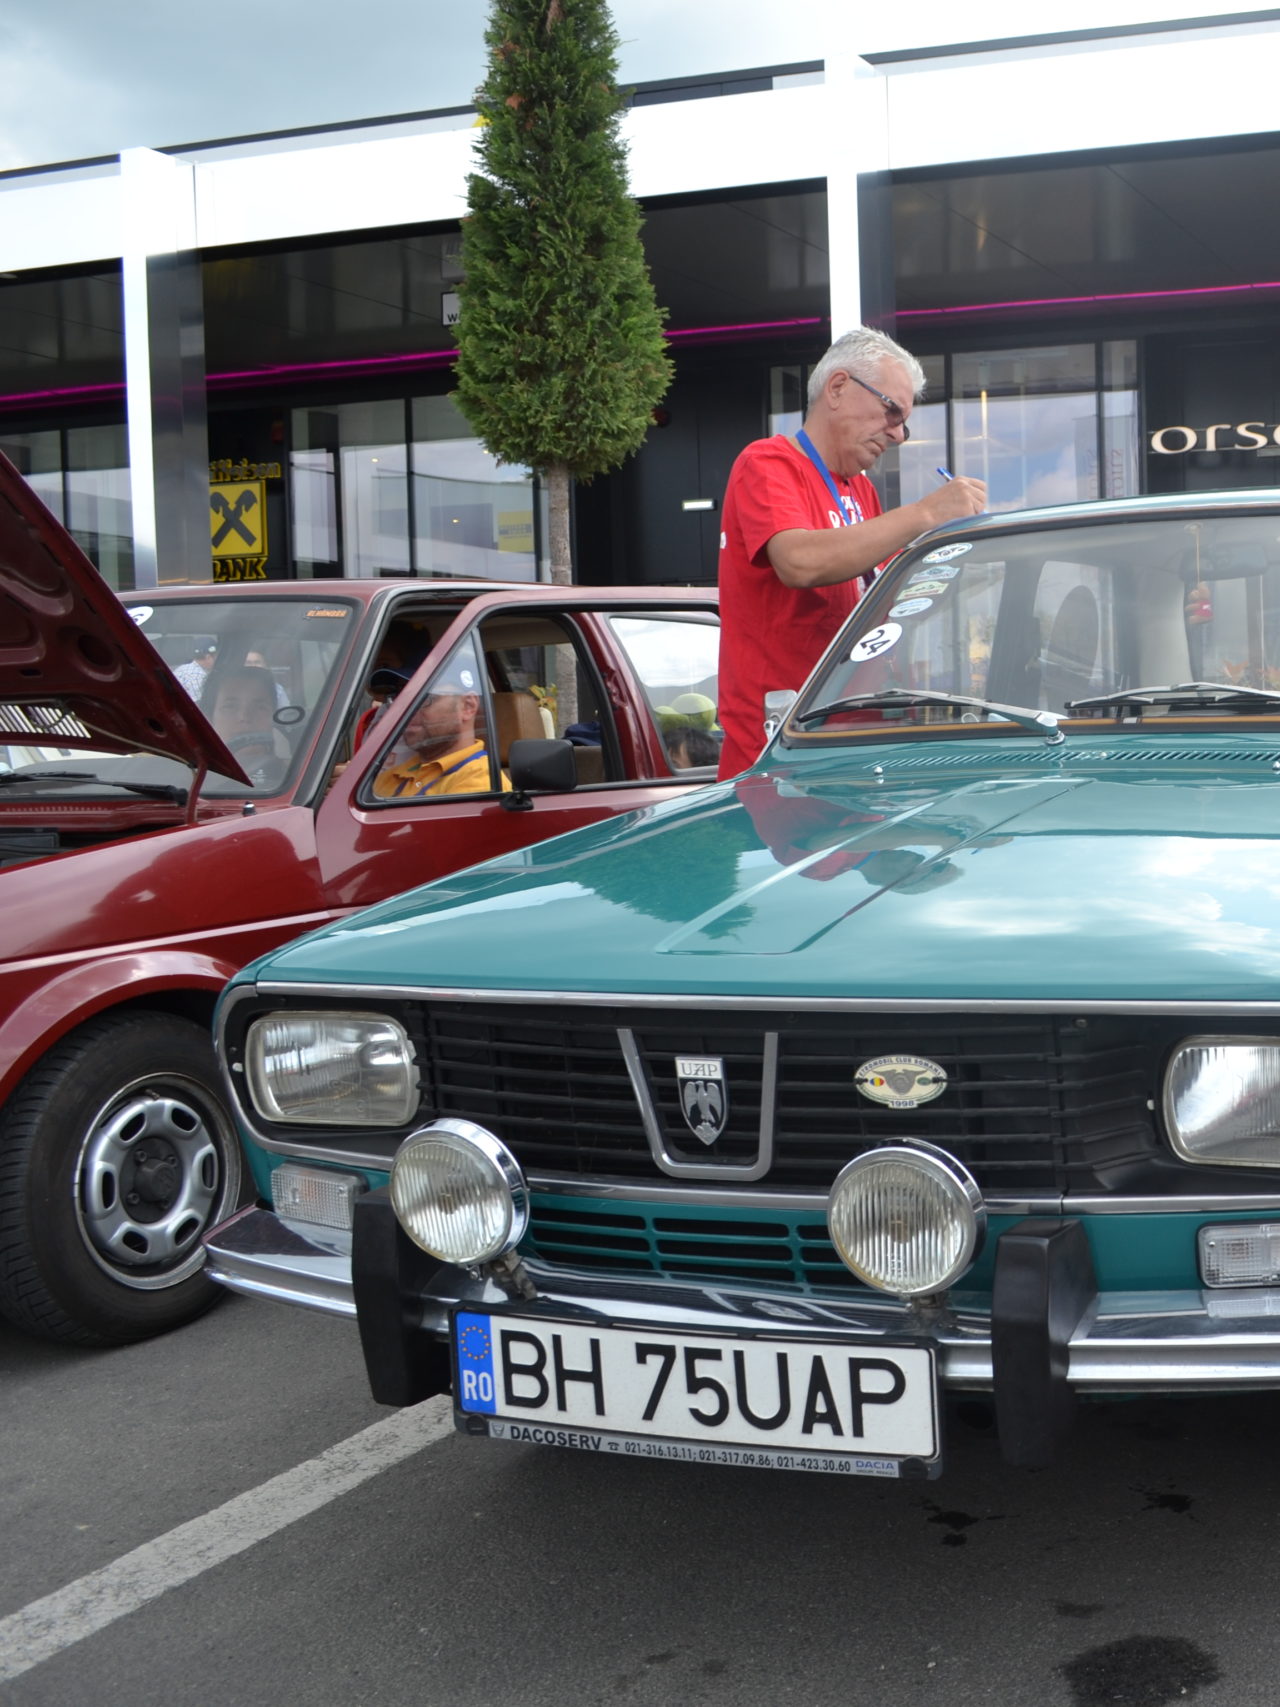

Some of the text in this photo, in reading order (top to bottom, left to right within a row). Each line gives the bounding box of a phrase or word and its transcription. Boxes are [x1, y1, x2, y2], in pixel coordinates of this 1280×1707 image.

[860, 629, 890, 656] 24
[680, 1062, 719, 1077] UAP
[463, 1369, 493, 1403] RO
[500, 1328, 605, 1416] BH
[510, 1425, 851, 1473] DACOSERV 021-316.13.11; 021-317.09.86; 021-423.30.60
[855, 1460, 895, 1470] DACIA
